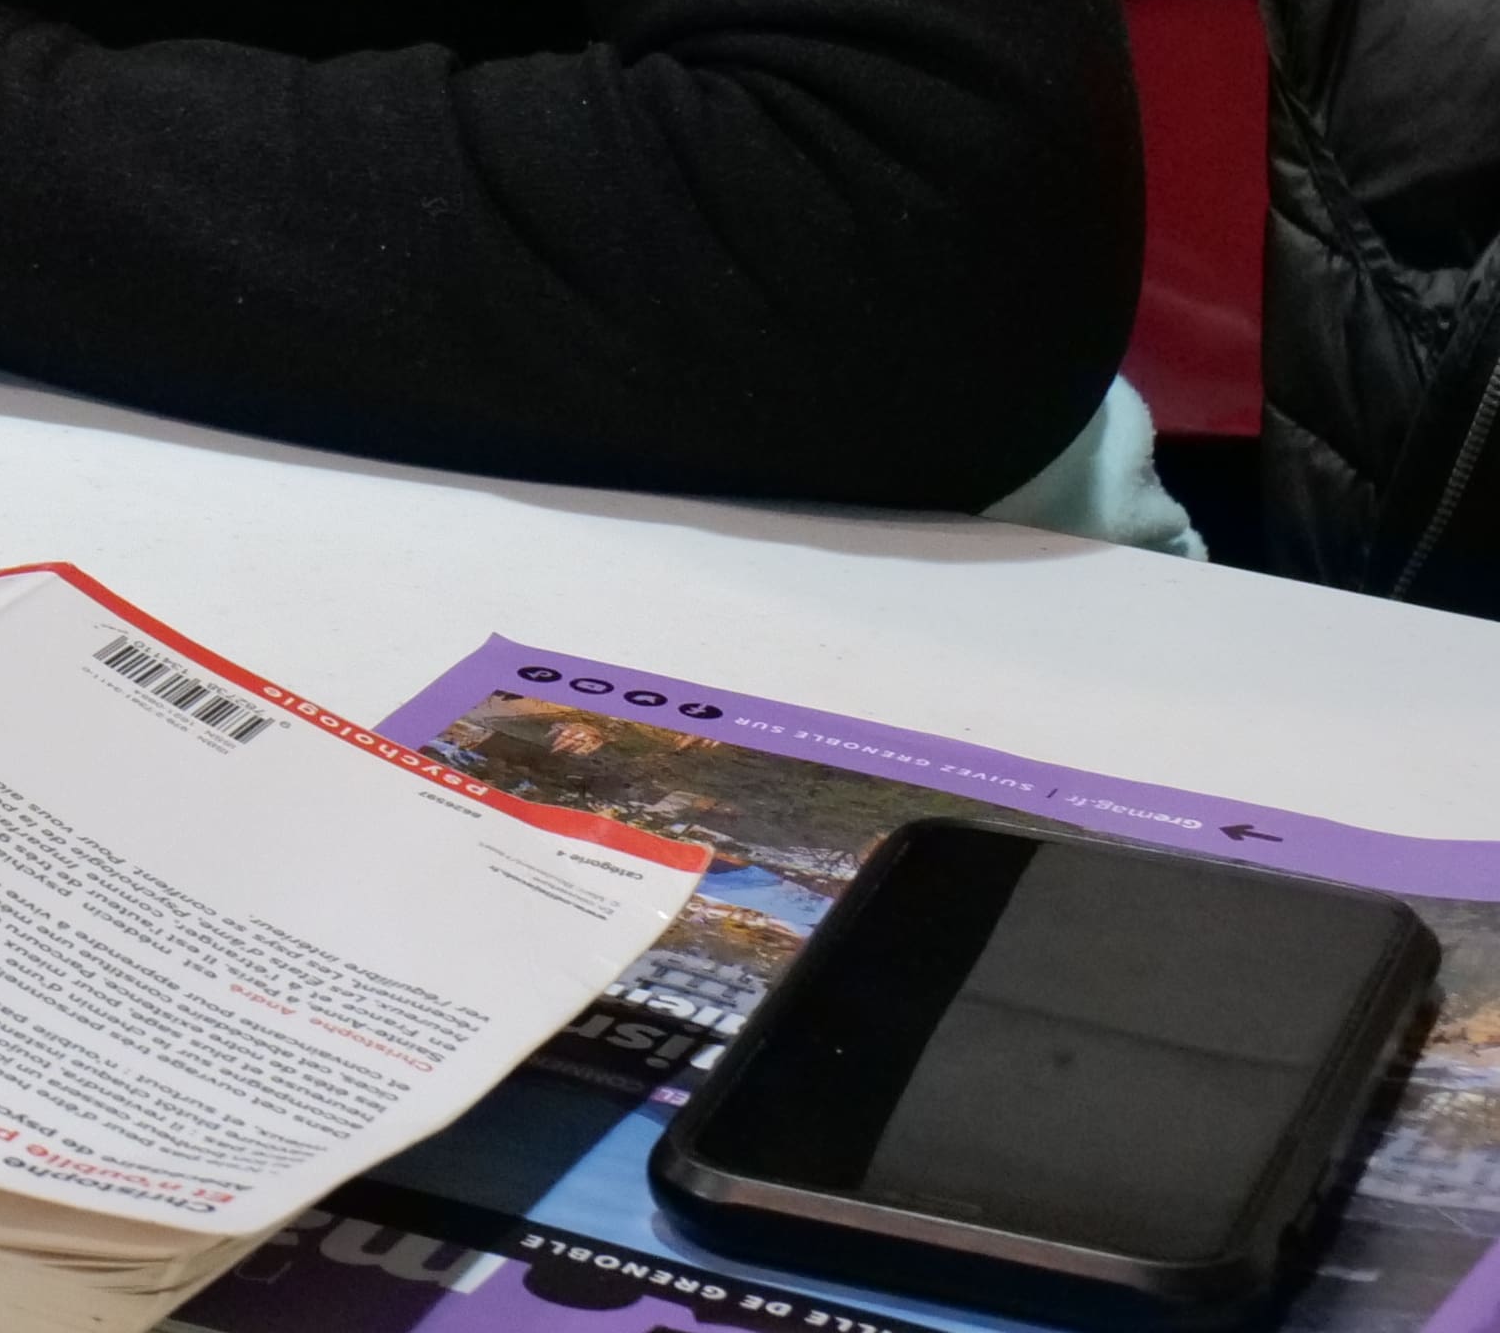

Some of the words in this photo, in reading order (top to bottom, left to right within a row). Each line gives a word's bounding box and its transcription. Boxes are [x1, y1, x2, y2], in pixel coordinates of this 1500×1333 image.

[733, 716, 787, 735] SUR
[259, 684, 488, 797] psychologie
[793, 730, 931, 768] GRENOBLE
[939, 764, 1035, 792] SUIVEZ
[18, 814, 39, 828] la
[27, 803, 74, 834] vous
[1065, 794, 1204, 830] Gremag.fr
[40, 828, 68, 846] de
[76, 836, 127, 865] Pour
[13, 844, 53, 872] très
[567, 852, 643, 880] catégorie
[56, 871, 83, 888] de
[70, 846, 192, 918] Psychologie
[5, 889, 52, 921] vivre
[85, 872, 165, 918] comme
[35, 925, 75, 950] une
[81, 901, 173, 955] médecin
[221, 917, 248, 933] se
[4, 923, 97, 980] Parcouru
[165, 933, 201, 954] est
[251, 933, 305, 960] psys
[3, 939, 68, 978] mieux
[74, 930, 181, 991] apprendre
[182, 958, 218, 980] est
[201, 953, 218, 966] Il
[268, 956, 326, 987] États
[305, 959, 345, 981] Les
[78, 949, 174, 1004] constitue
[70, 979, 123, 1009] pour
[183, 992, 236, 1019] pour
[229, 983, 297, 1016] André
[308, 990, 333, 1003] et
[328, 985, 368, 1003] Les
[67, 992, 147, 1037] chemin
[341, 1003, 420, 1038] France
[455, 1006, 491, 1023] ver
[108, 1030, 152, 1056] très
[151, 1036, 173, 1051] le
[176, 1003, 295, 1059] abécédaire
[427, 1036, 458, 1052] en
[176, 1049, 214, 1068] sur
[189, 1038, 239, 1064] plus
[208, 1032, 265, 1061] notre
[238, 1017, 384, 1081] convaincante
[308, 1017, 434, 1073] Christophe
[156, 1054, 248, 1098] ouvrage
[240, 1062, 265, 1076] et
[268, 1060, 298, 1075] de
[297, 1057, 333, 1075] cet
[218, 1067, 365, 1130] accompagne
[301, 1073, 350, 1097] étés
[386, 1078, 412, 1092] et
[250, 1096, 288, 1115] cet
[269, 1075, 376, 1124] heureuse
[354, 1095, 388, 1114] les
[61, 1137, 95, 1156] de
[2, 1156, 217, 1214] Christophe
[191, 1188, 236, 1204] Et
[518, 1233, 728, 1301] GRENOBLE
[739, 1295, 793, 1317] DE
